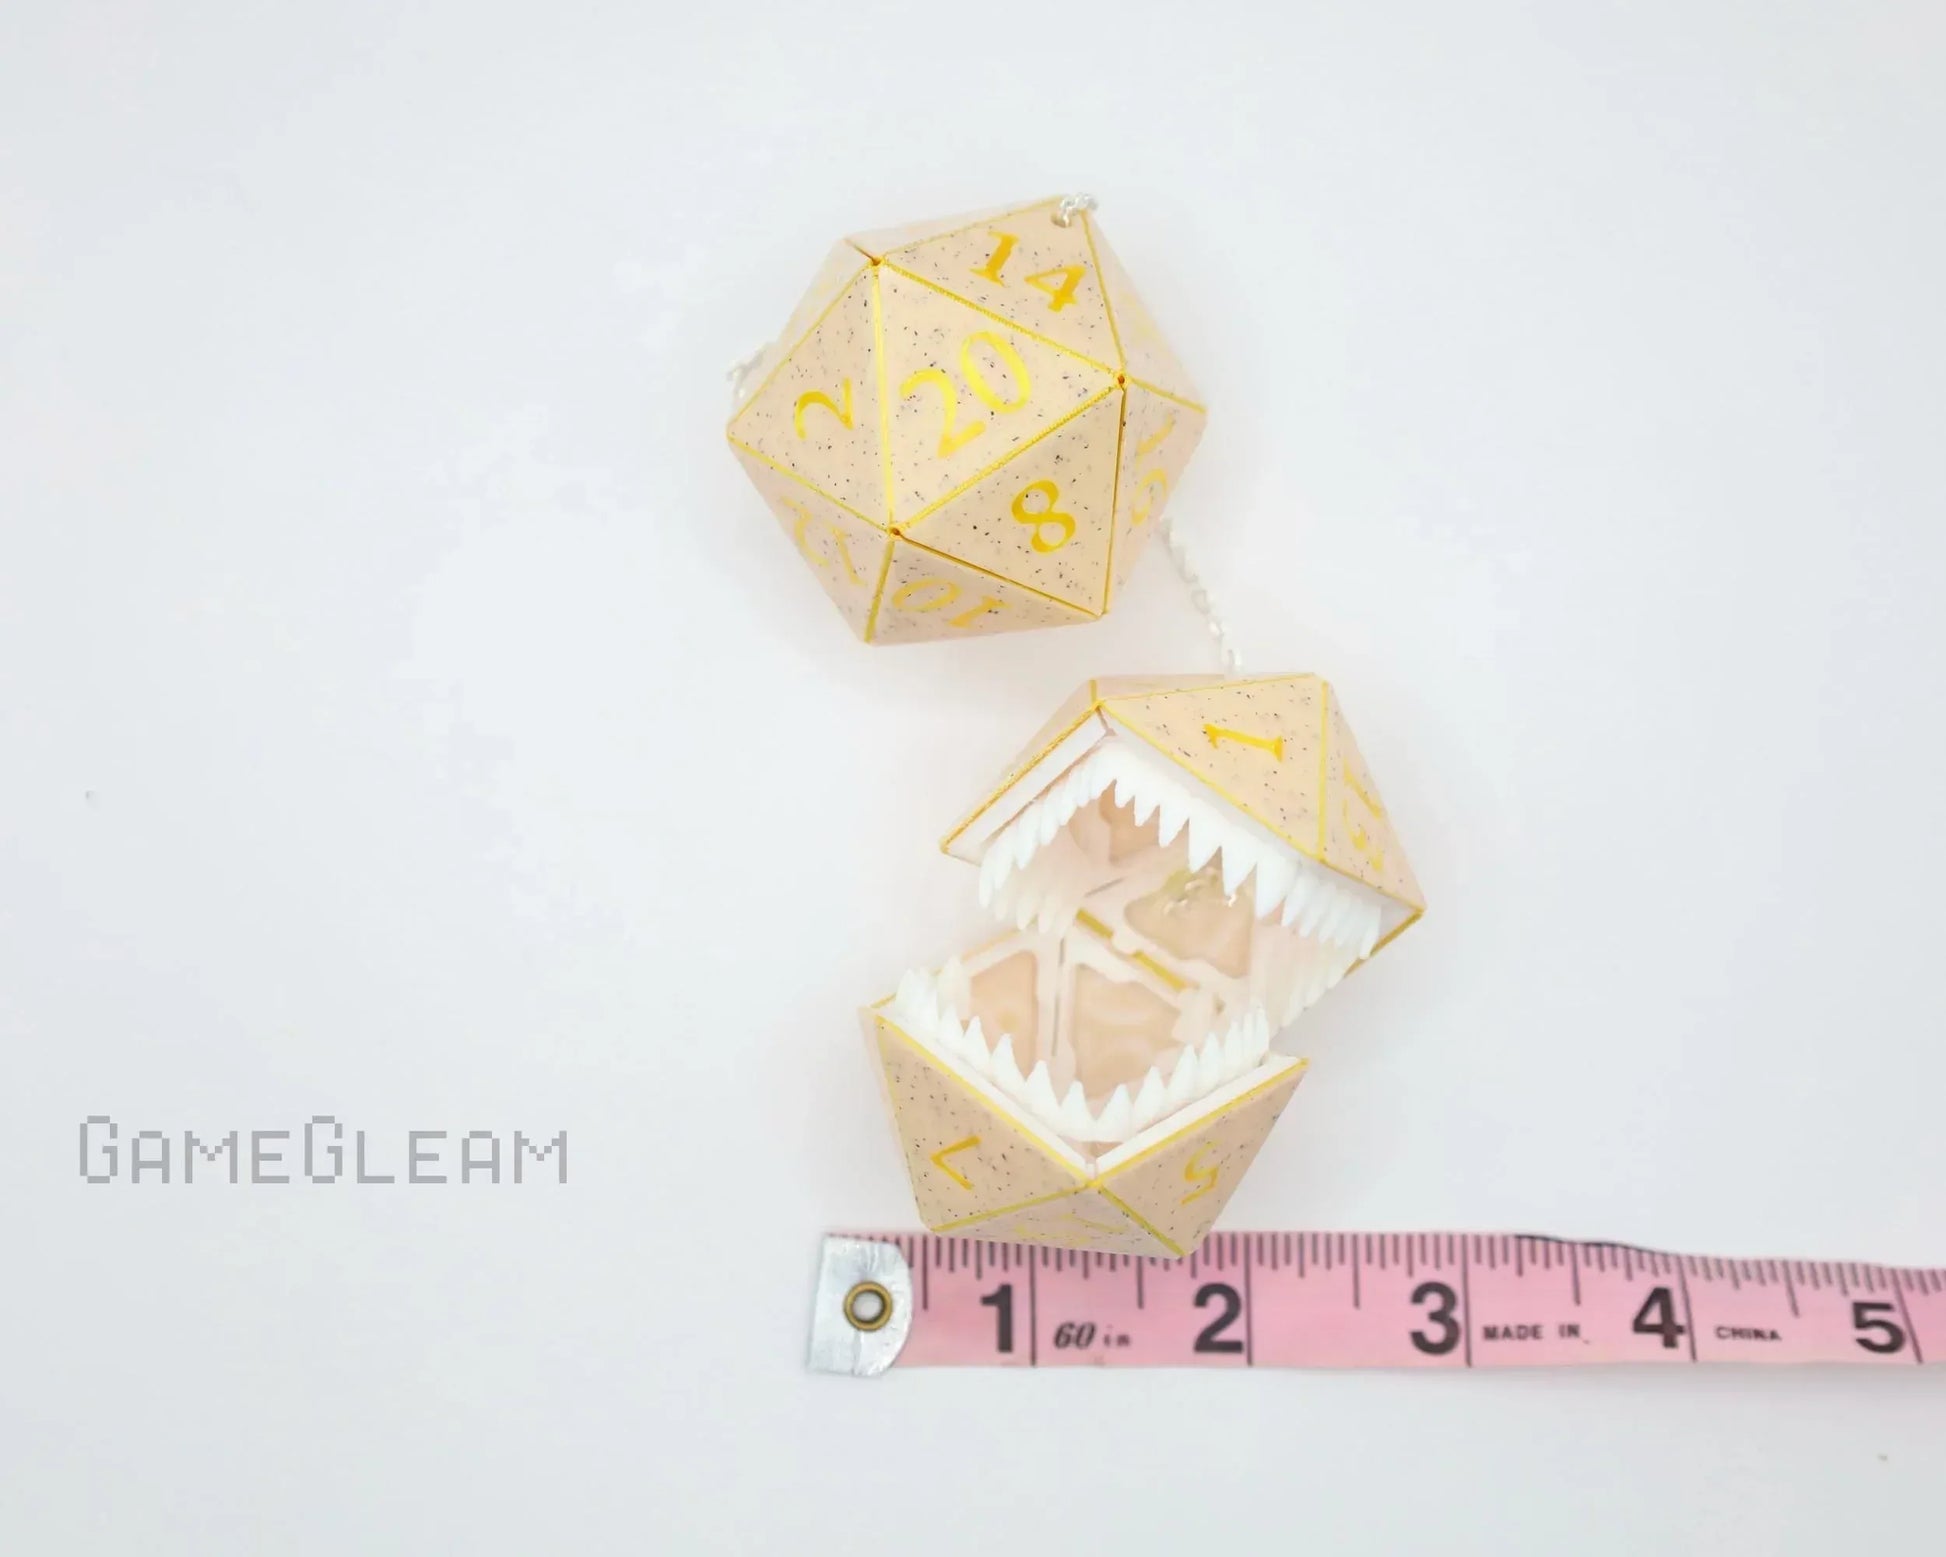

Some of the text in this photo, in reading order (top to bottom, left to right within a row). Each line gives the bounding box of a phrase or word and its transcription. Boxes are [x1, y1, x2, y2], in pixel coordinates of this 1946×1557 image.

[970, 230, 1087, 313] 14
[793, 377, 855, 440] 2
[899, 330, 1032, 460] 20
[1010, 478, 1077, 555] 8
[891, 577, 1012, 629] 10
[1202, 722, 1285, 763] 1
[979, 1283, 1013, 1354] 1
[1052, 1321, 1097, 1350] 60
[1192, 1282, 1244, 1354] 2
[1410, 1281, 1461, 1356] 3
[1482, 1323, 1581, 1342] MADE IN
[1632, 1286, 1685, 1349] 4
[1714, 1325, 1784, 1343] CHINA
[1852, 1301, 1905, 1354] 5
